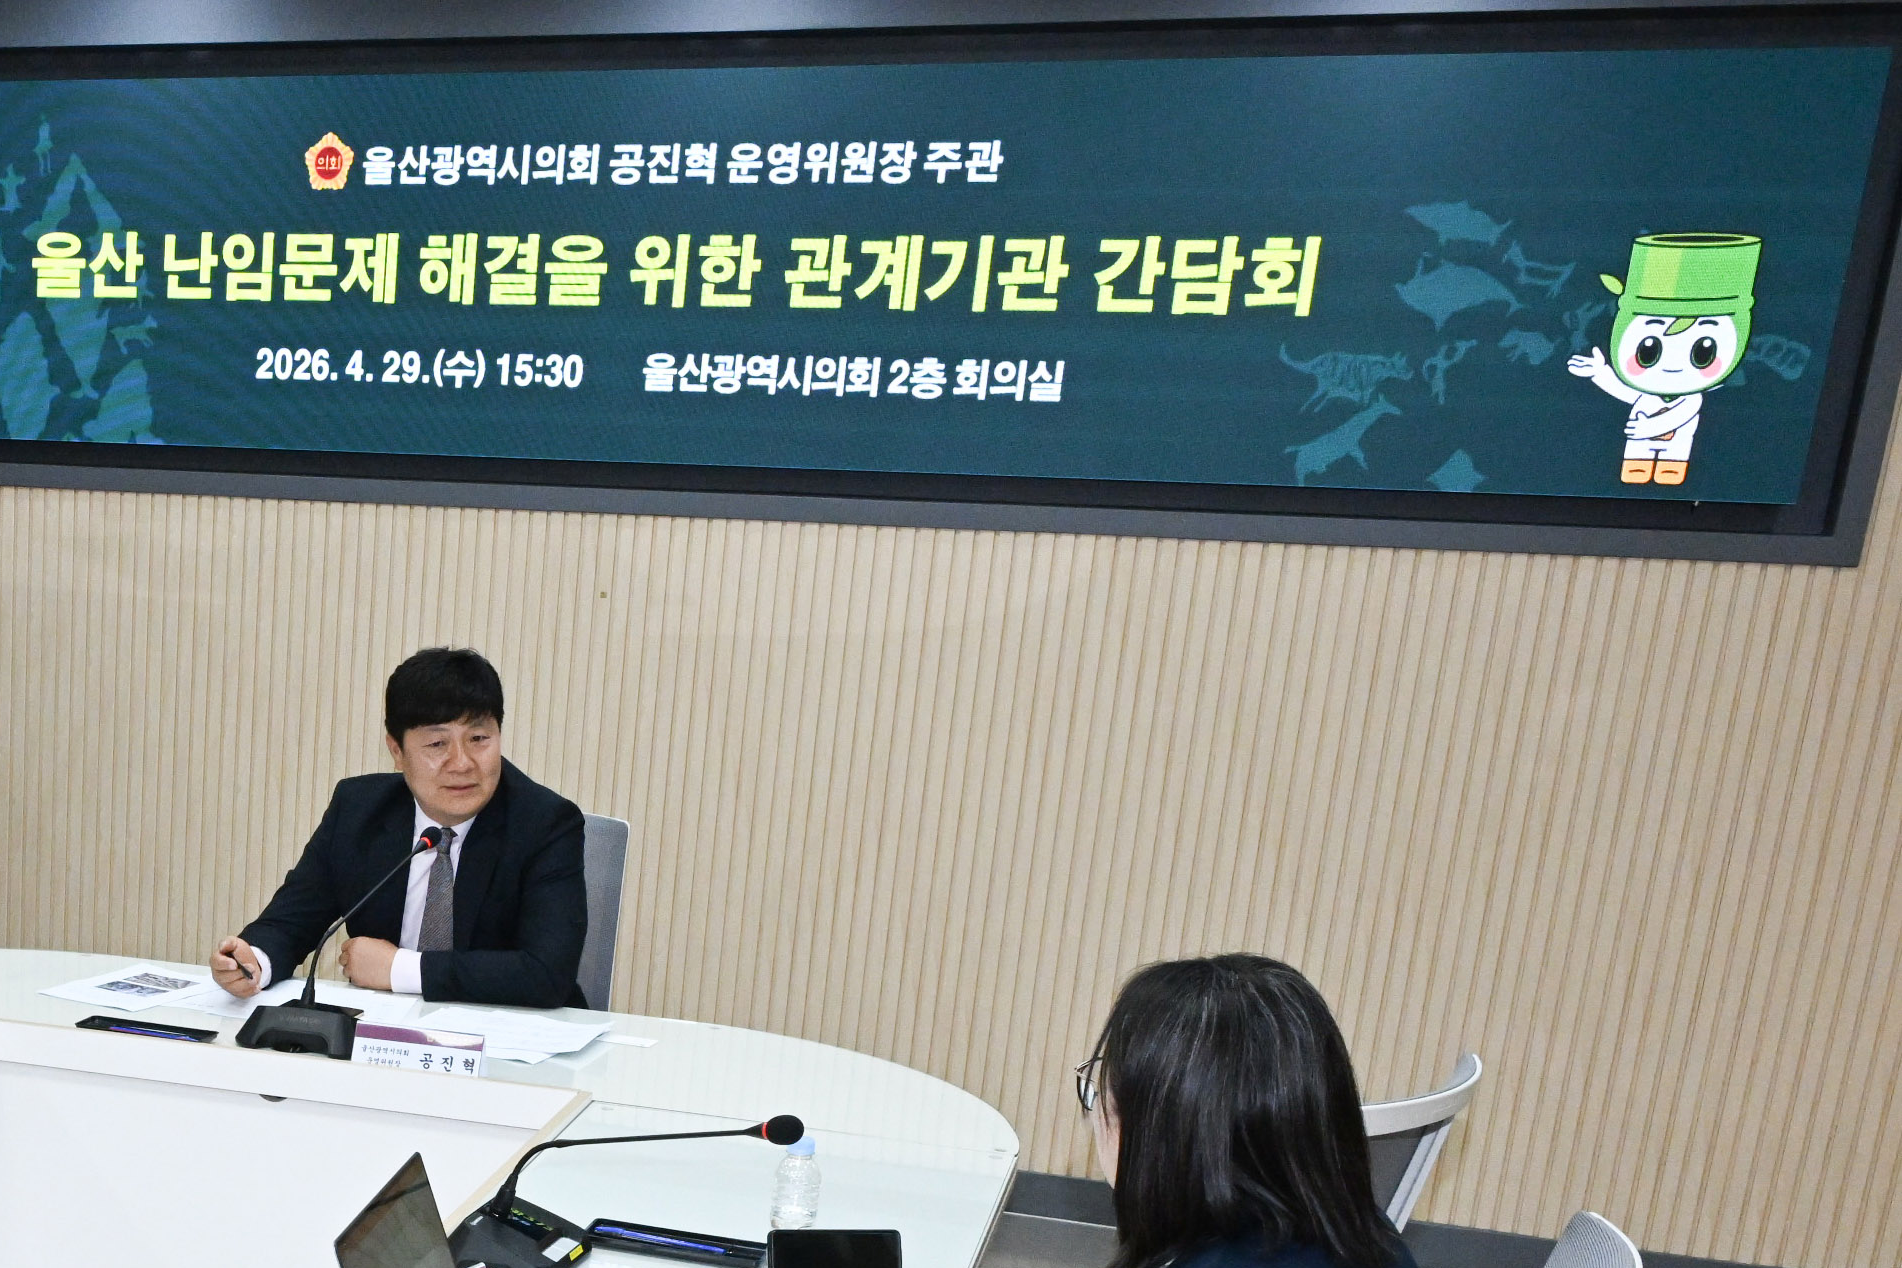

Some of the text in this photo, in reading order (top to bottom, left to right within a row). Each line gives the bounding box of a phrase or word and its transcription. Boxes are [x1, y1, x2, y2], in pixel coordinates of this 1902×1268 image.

[362, 139, 1005, 186] 울산광역시의회 공진혁 운영위원장 주관
[31, 231, 1322, 317] 울산 난임문제 해결을 위한 관계기관 간담회
[255, 347, 338, 382] 2026.
[344, 349, 374, 383] 4.
[496, 353, 584, 388] 15:30
[642, 352, 1066, 403] 울산광역시의회 2층 회의실
